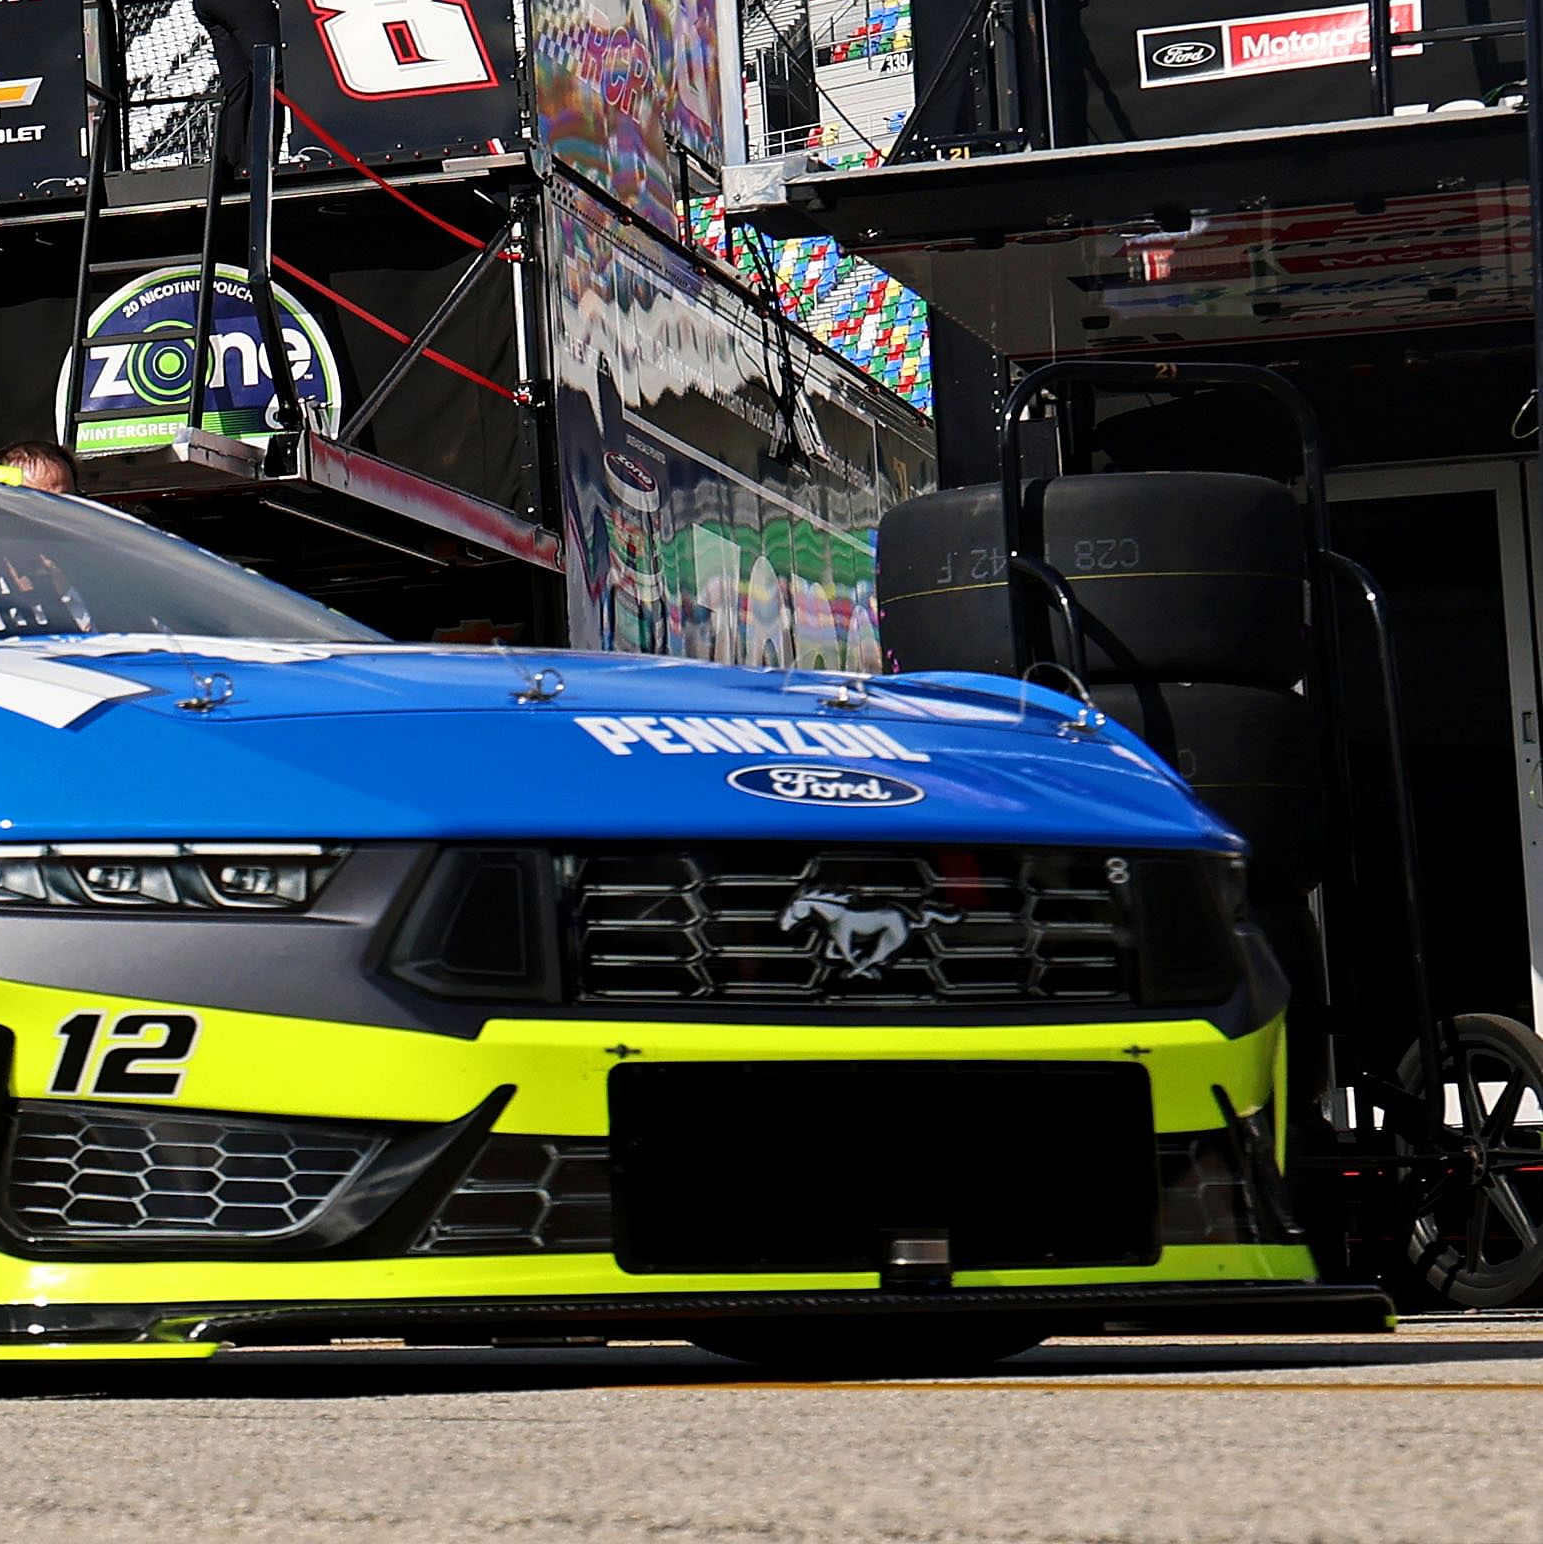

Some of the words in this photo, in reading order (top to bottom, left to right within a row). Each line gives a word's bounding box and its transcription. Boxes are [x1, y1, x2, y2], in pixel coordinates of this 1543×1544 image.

[577, 2, 652, 124] RCR
[886, 52, 908, 74] 339
[122, 300, 140, 319] 20
[572, 715, 932, 763] PENNZOIL
[768, 767, 893, 802] Ford
[48, 1011, 199, 1098] 12
